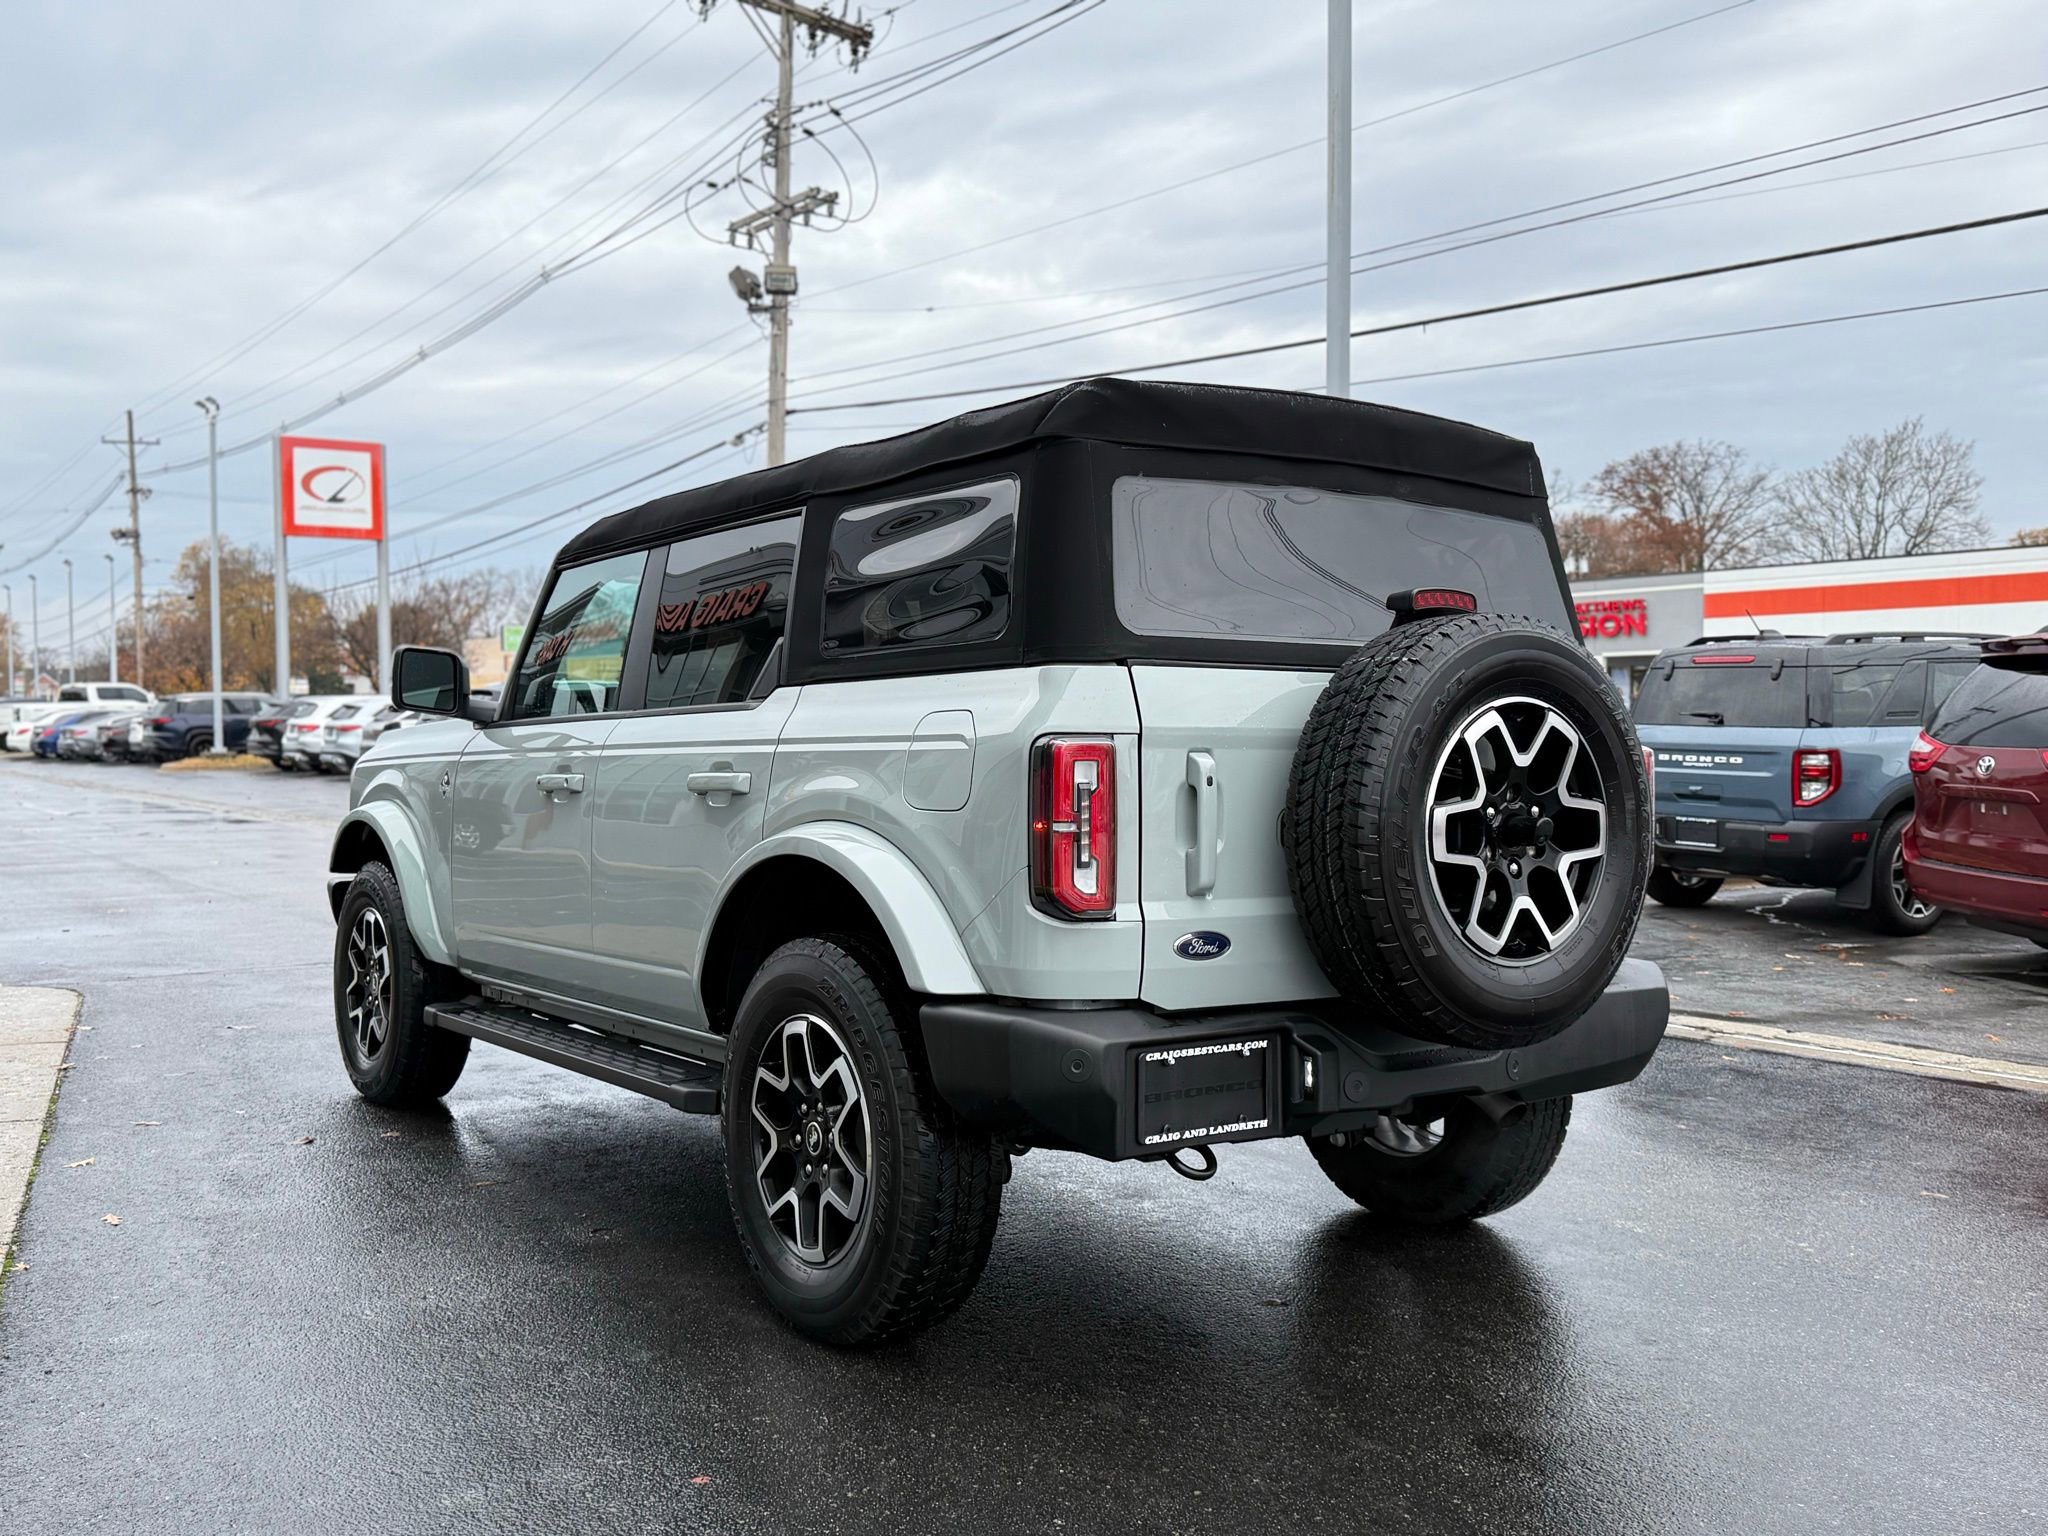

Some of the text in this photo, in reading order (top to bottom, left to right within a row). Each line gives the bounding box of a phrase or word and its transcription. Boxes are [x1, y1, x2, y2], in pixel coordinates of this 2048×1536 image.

[1574, 598, 1646, 614] ATTHEWS
[1577, 613, 1648, 638] SION
[1658, 753, 1743, 764] BRONCO
[1188, 938, 1219, 954] Ford
[1145, 1040, 1268, 1061] CRAIGSBESTCARS.COM
[1144, 1079, 1264, 1104] BRONCO
[1145, 1120, 1268, 1145] CRAIG AND LANDRETH
